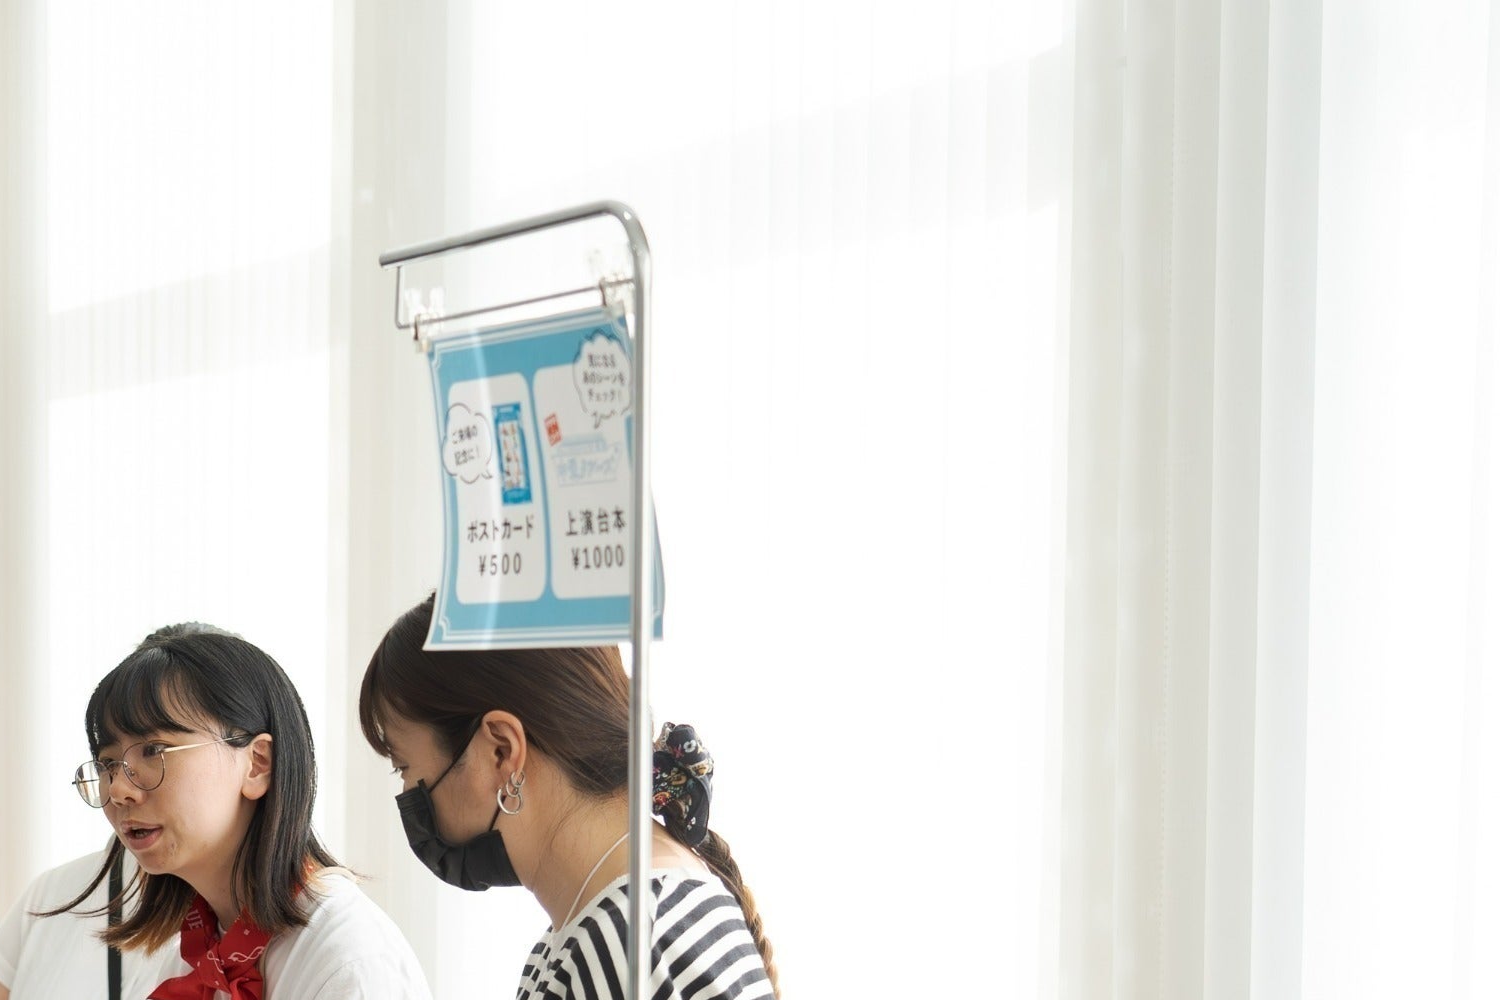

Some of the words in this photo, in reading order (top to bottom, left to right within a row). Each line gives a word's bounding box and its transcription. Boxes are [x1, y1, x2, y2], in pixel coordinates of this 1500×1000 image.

[467, 515, 534, 543] ポストカード
[566, 505, 626, 537] 上演台本
[479, 552, 522, 577] ¥500
[571, 544, 625, 571] ¥1000
